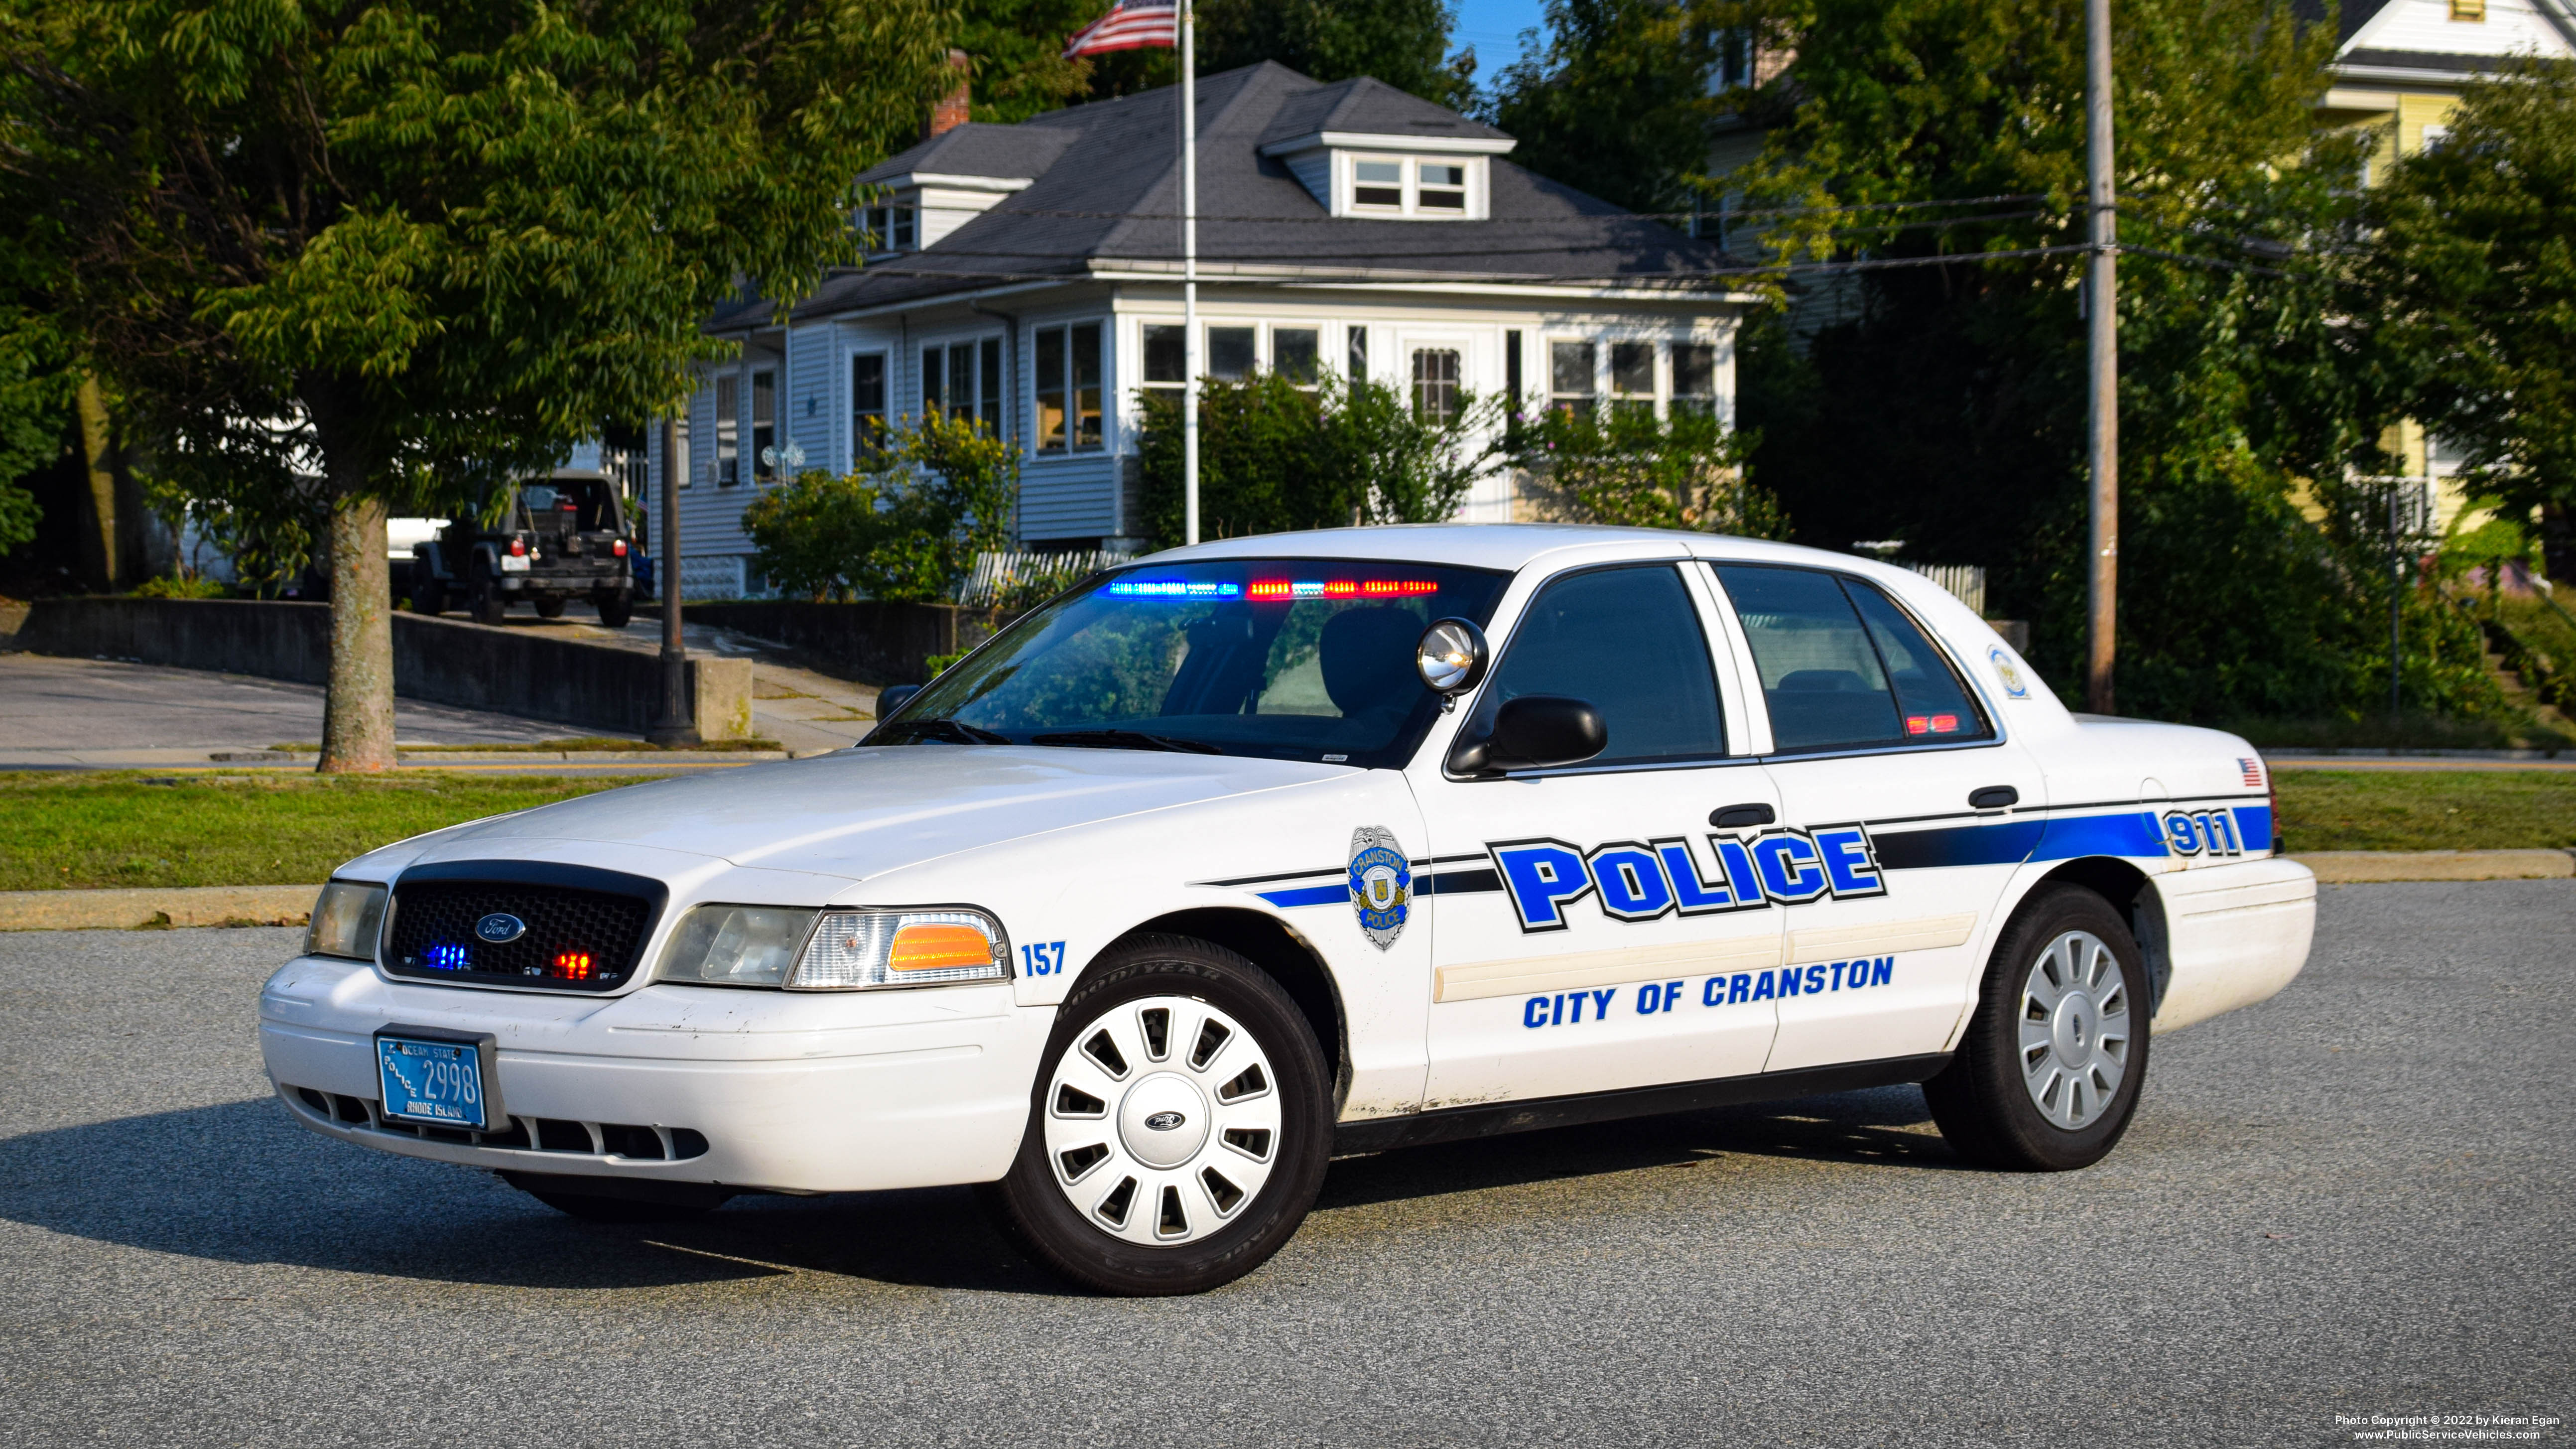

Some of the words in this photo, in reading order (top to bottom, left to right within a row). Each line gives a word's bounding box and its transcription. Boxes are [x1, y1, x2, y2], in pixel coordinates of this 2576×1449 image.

[2163, 809, 2241, 856] 911
[1353, 849, 1404, 876] CRANSTON
[1488, 824, 1888, 935] POLICE
[485, 918, 511, 935] Ford
[1366, 910, 1400, 927] POLICE
[1021, 940, 1066, 977] 157
[1523, 988, 1616, 1029] CITY
[1636, 981, 1683, 1015] OF
[1702, 956, 1894, 1007] CRANSTON
[402, 1045, 428, 1056] OCEAN
[433, 1048, 457, 1061] STATE
[384, 1055, 417, 1098] POLICE
[423, 1059, 476, 1104] 2998
[407, 1100, 432, 1116] RHODE
[435, 1103, 462, 1119] ISLAND
